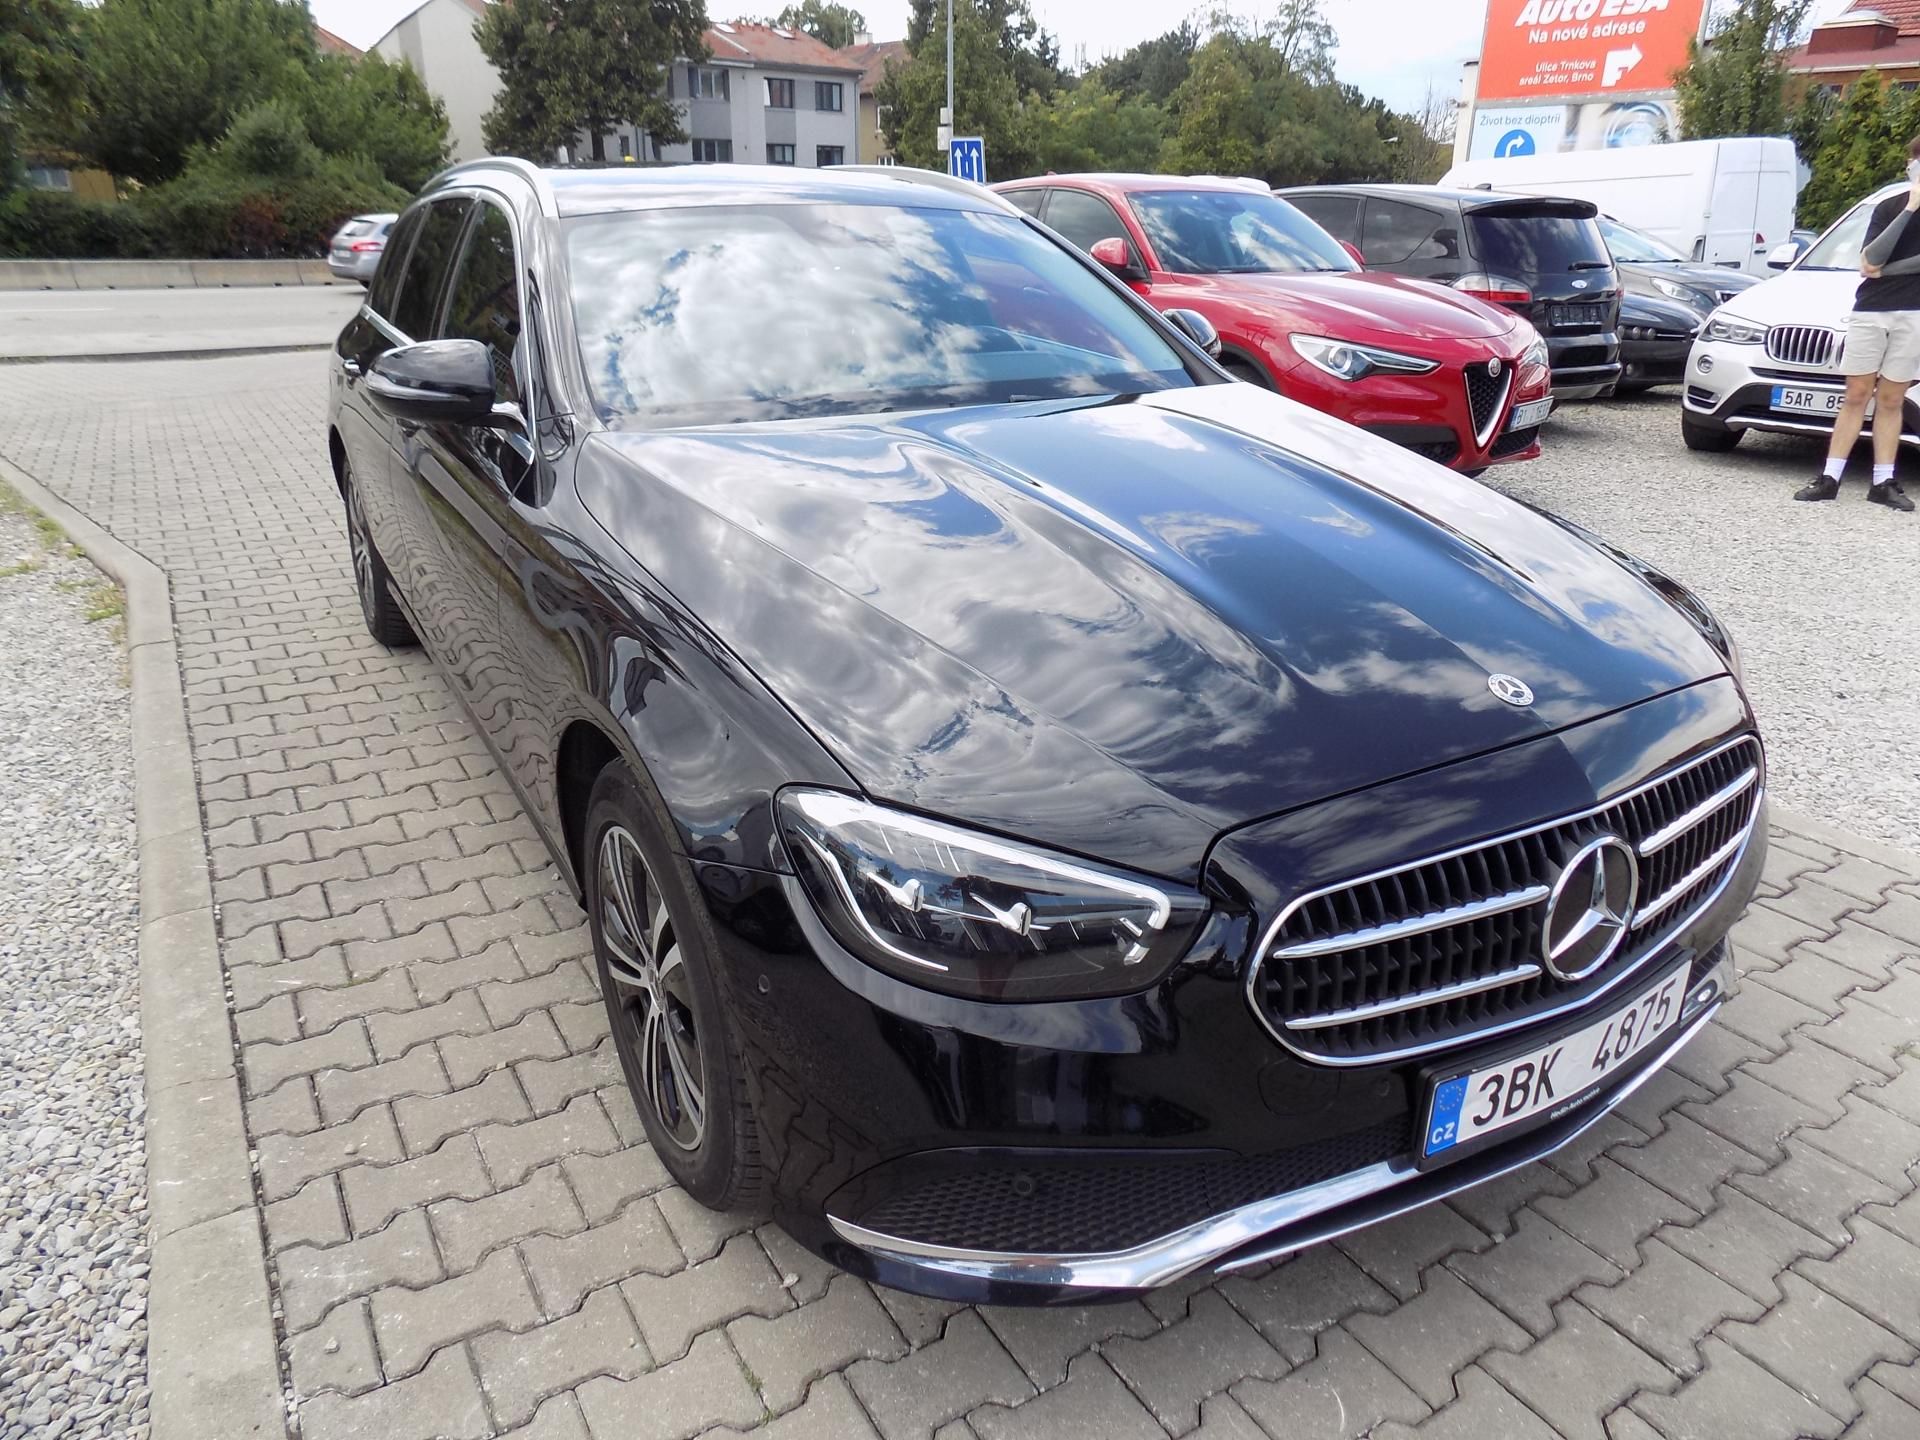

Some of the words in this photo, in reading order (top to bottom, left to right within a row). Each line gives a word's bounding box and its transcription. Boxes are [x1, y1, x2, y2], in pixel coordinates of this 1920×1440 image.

[1528, 29, 1548, 44] Na
[1552, 23, 1587, 42] nové
[1591, 19, 1646, 38] adrese
[1535, 62, 1558, 73] Ulice
[1560, 59, 1597, 71] Trnkova
[1519, 73, 1541, 86] areál
[1543, 73, 1570, 85] Zetor,
[1571, 71, 1594, 83] Brno
[1480, 114, 1503, 127] Život
[1505, 115, 1523, 126] bez
[1785, 391, 1814, 408] 5AR
[1826, 395, 1846, 411] 85
[1431, 1122, 1456, 1145] CZ
[1473, 1046, 1562, 1127] 3BK
[1591, 978, 1677, 1072] 4875
